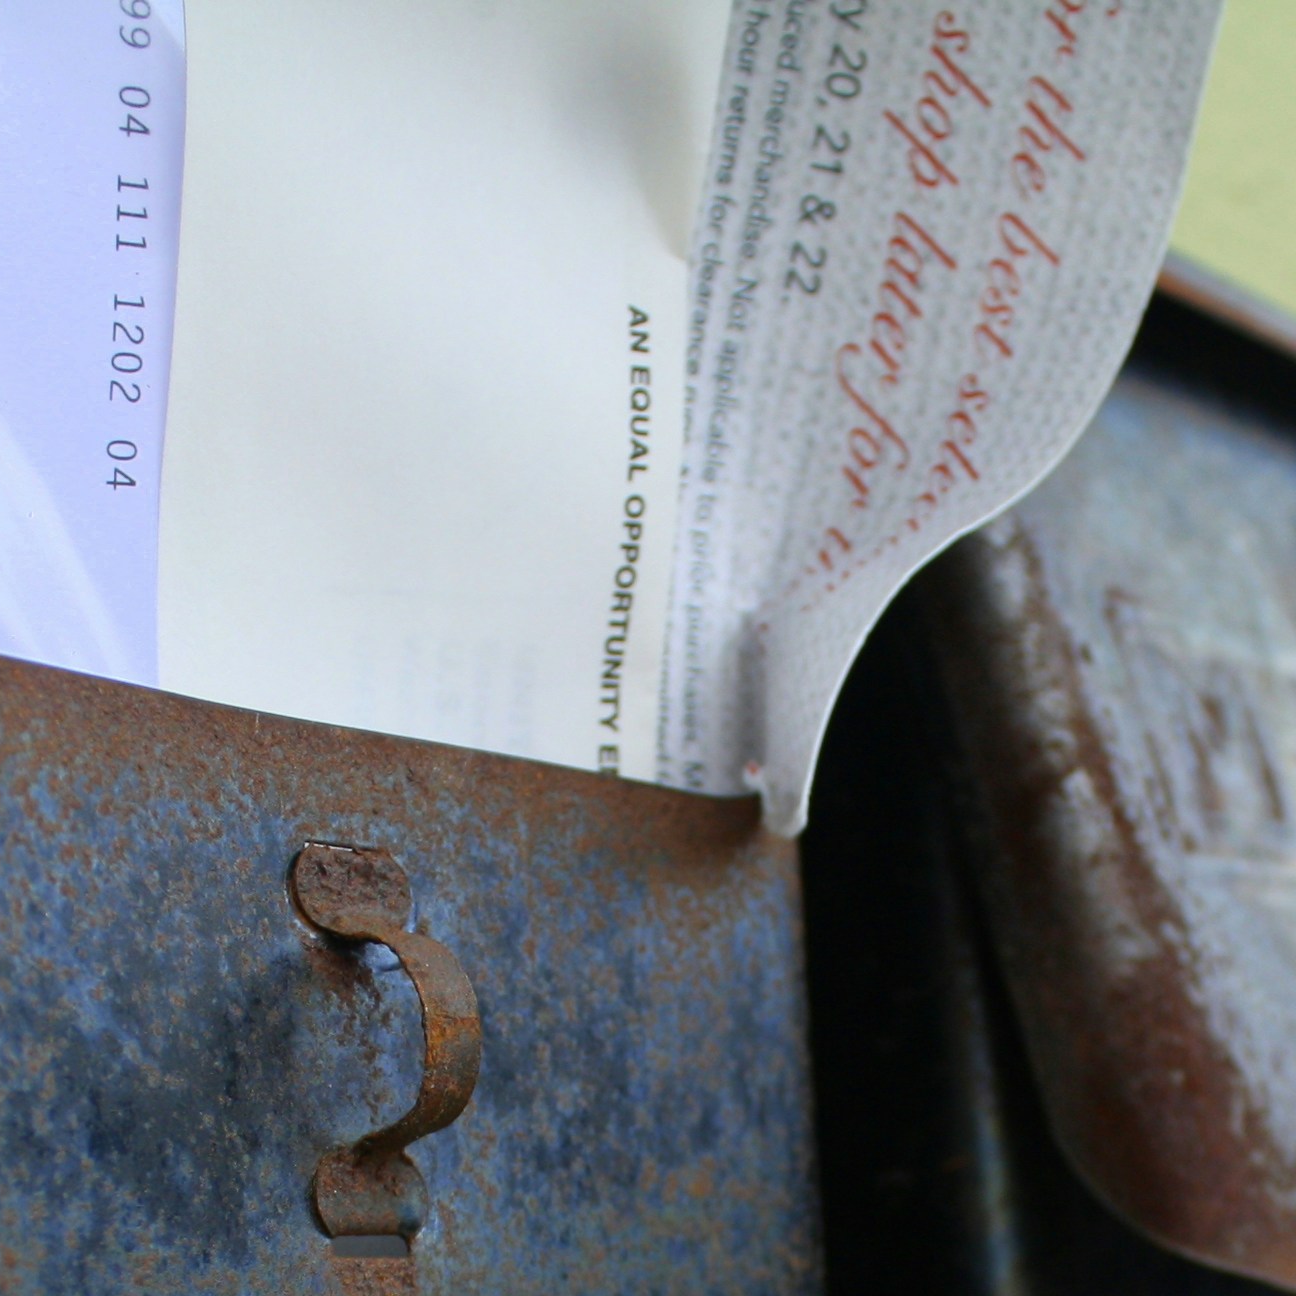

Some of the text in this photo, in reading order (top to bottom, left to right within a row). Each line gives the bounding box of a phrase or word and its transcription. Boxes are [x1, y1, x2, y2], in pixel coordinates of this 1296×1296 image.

[736, 9, 770, 75] hour
[816, 43, 868, 108] 20,
[714, 83, 750, 185] returns
[809, 123, 852, 176] 21
[1012, 75, 1085, 198] the
[707, 194, 739, 235] for
[798, 193, 838, 226] &
[104, 0, 151, 492] 99 04 111 1202 04
[781, 241, 829, 304] 22.
[836, 10, 992, 508] shop later for
[727, 277, 760, 331] Not
[974, 211, 1061, 360] best
[627, 304, 649, 354] AN
[626, 364, 652, 483] EQUAL
[700, 339, 738, 483] applicable
[695, 494, 717, 521] to
[597, 494, 646, 732] OPPORTUNITY
